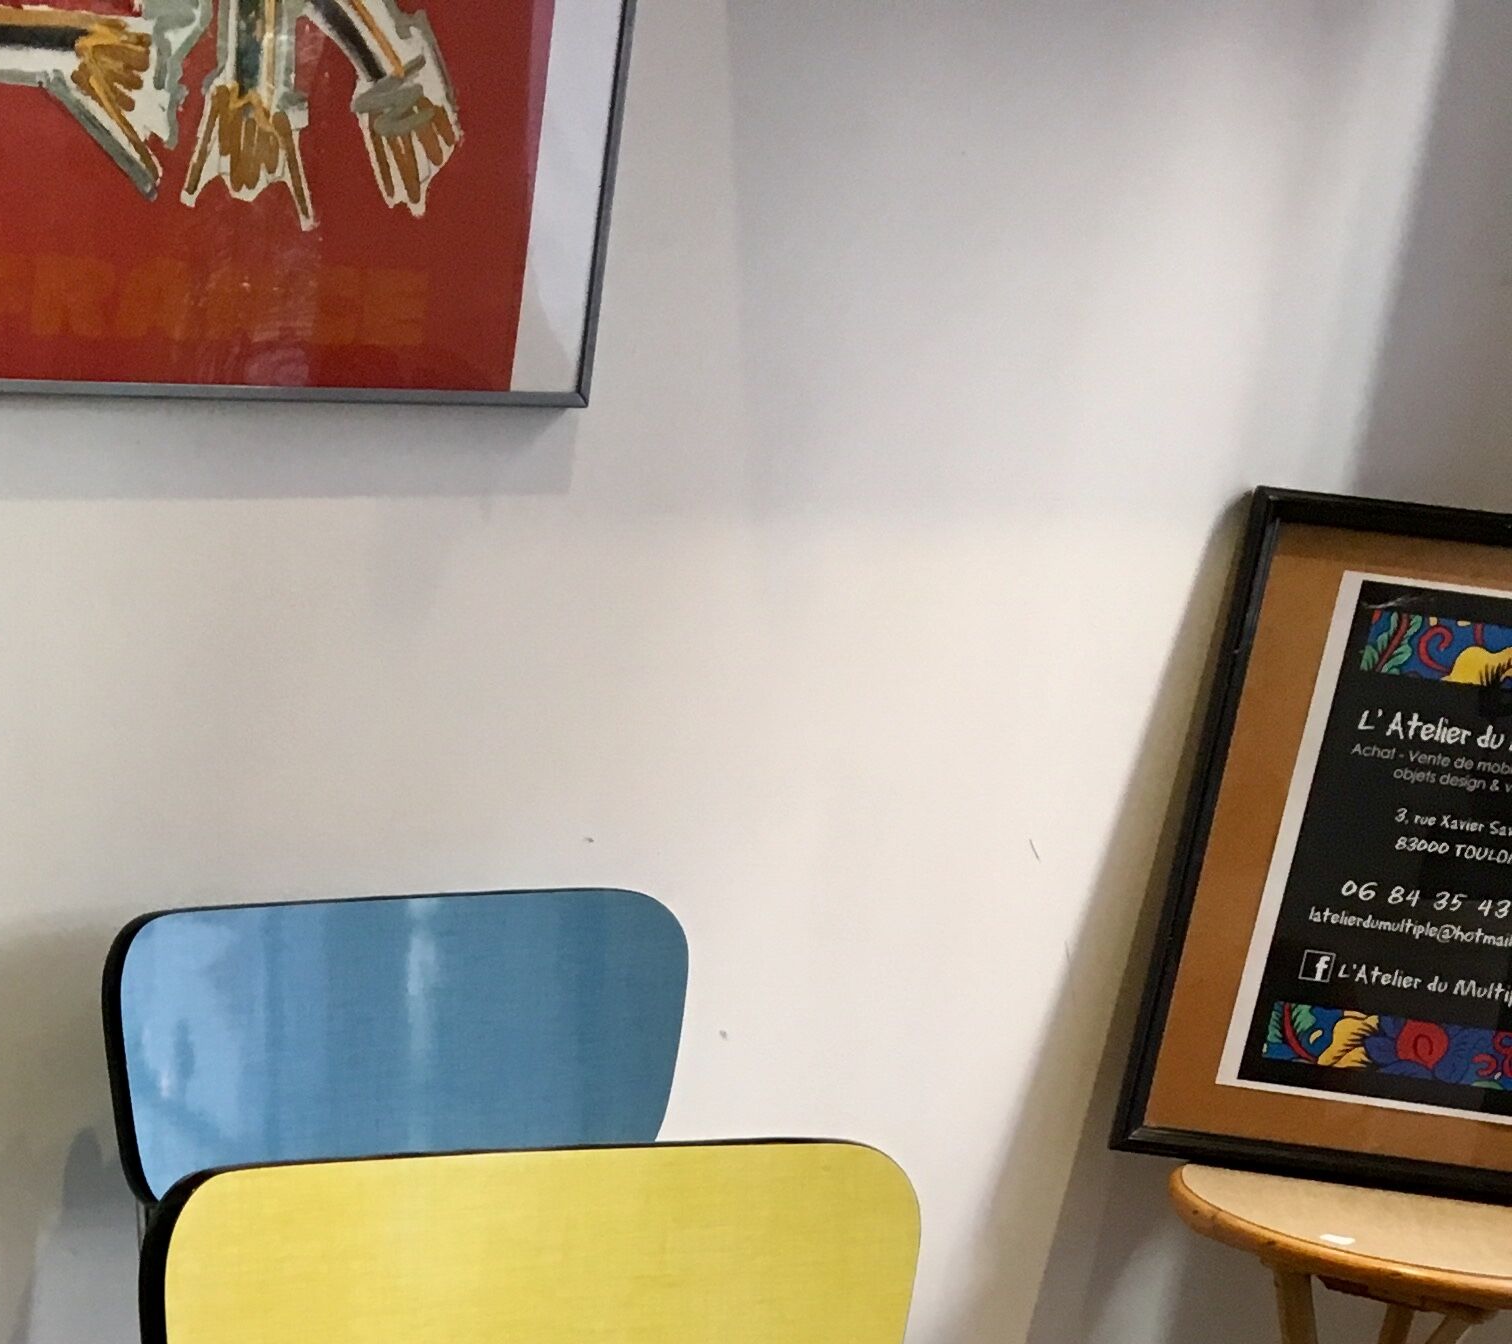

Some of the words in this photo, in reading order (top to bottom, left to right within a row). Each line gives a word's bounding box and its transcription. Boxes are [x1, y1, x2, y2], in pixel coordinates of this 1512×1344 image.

[1358, 709, 1472, 744] L'Atelier
[1477, 725, 1505, 749] du
[1352, 743, 1396, 760] Achat
[1409, 750, 1451, 767] Vente
[1454, 755, 1474, 770] de
[1393, 767, 1436, 784] objets
[1439, 772, 1486, 792] design
[1489, 779, 1500, 792] &
[1414, 814, 1437, 826] rue
[1440, 815, 1484, 832] Xavier
[1395, 836, 1449, 854] 83000
[1341, 880, 1378, 901] 06
[1387, 885, 1421, 907] 84
[1433, 891, 1468, 911] 35
[1478, 899, 1512, 919] 43
[1338, 963, 1422, 990] L'Atelier
[1427, 976, 1448, 993] du
